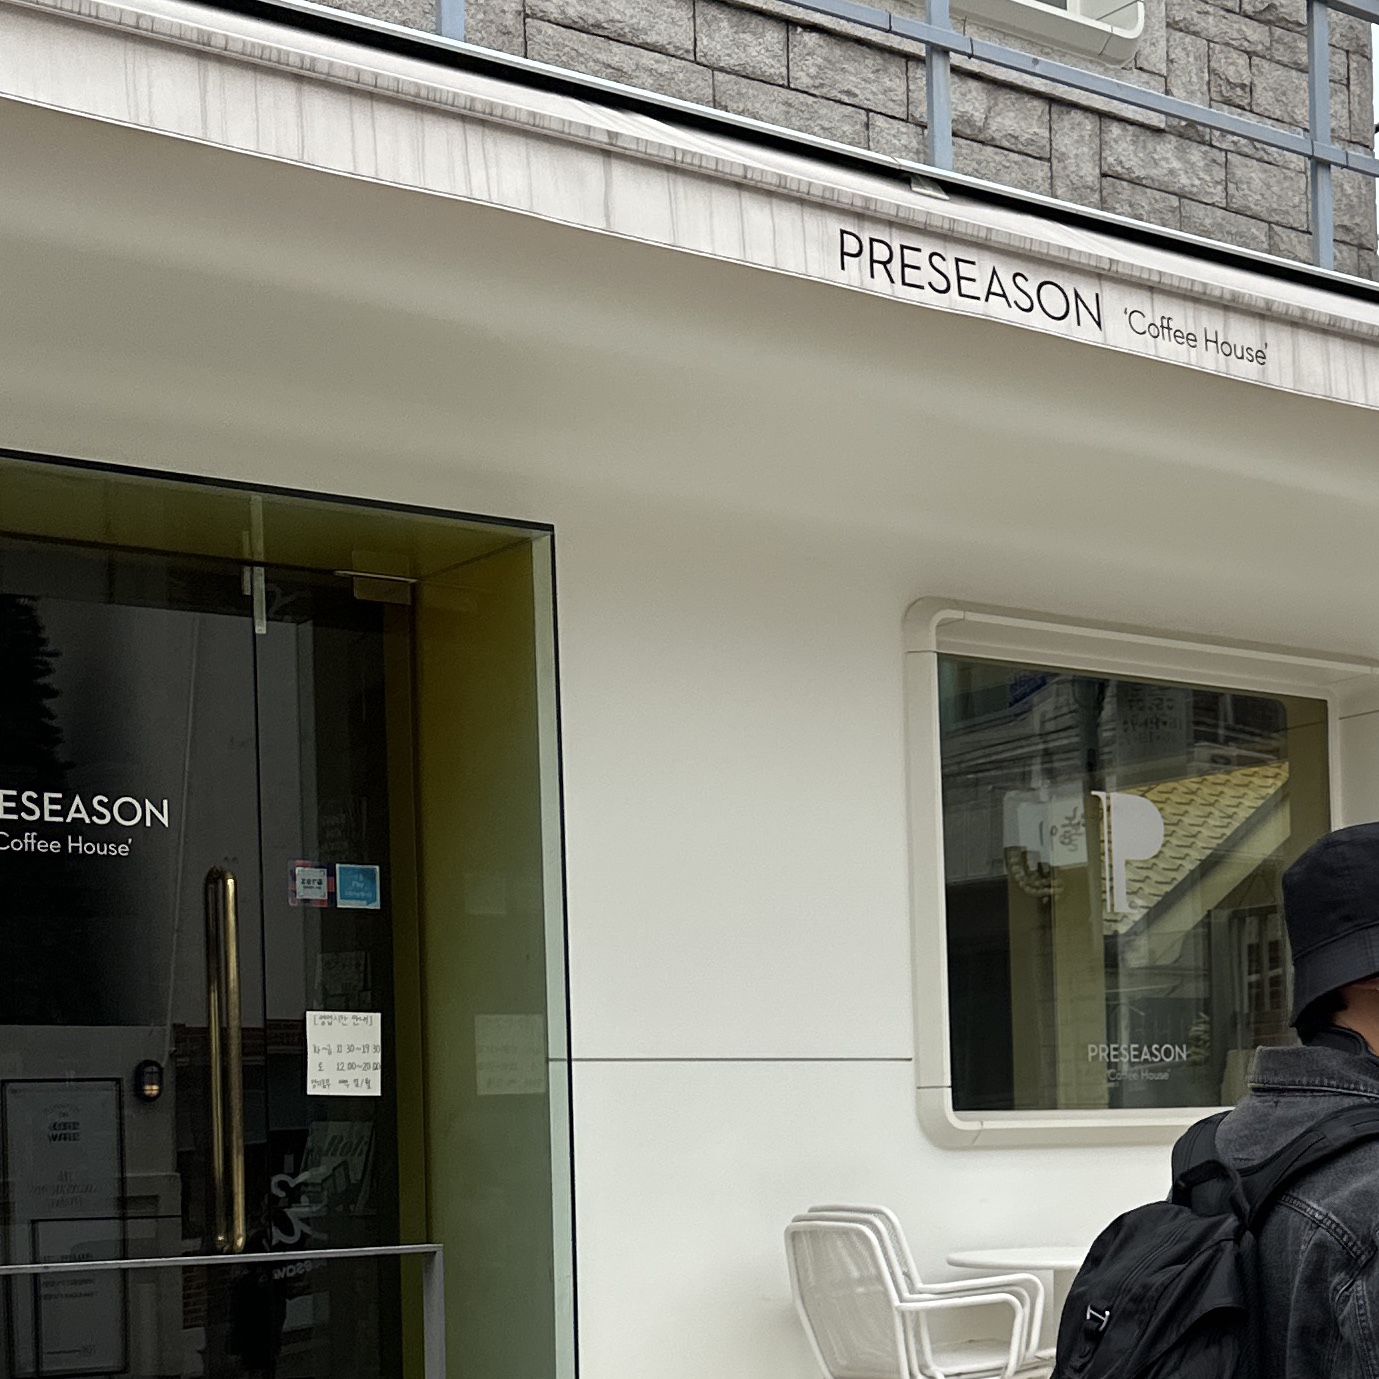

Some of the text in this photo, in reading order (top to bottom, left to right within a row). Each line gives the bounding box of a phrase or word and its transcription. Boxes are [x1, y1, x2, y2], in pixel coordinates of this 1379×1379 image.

[838, 228, 1102, 331] PRESEASON
[0, 789, 169, 828] ESEASON
[1087, 1043, 1187, 1062] PRESEASON
